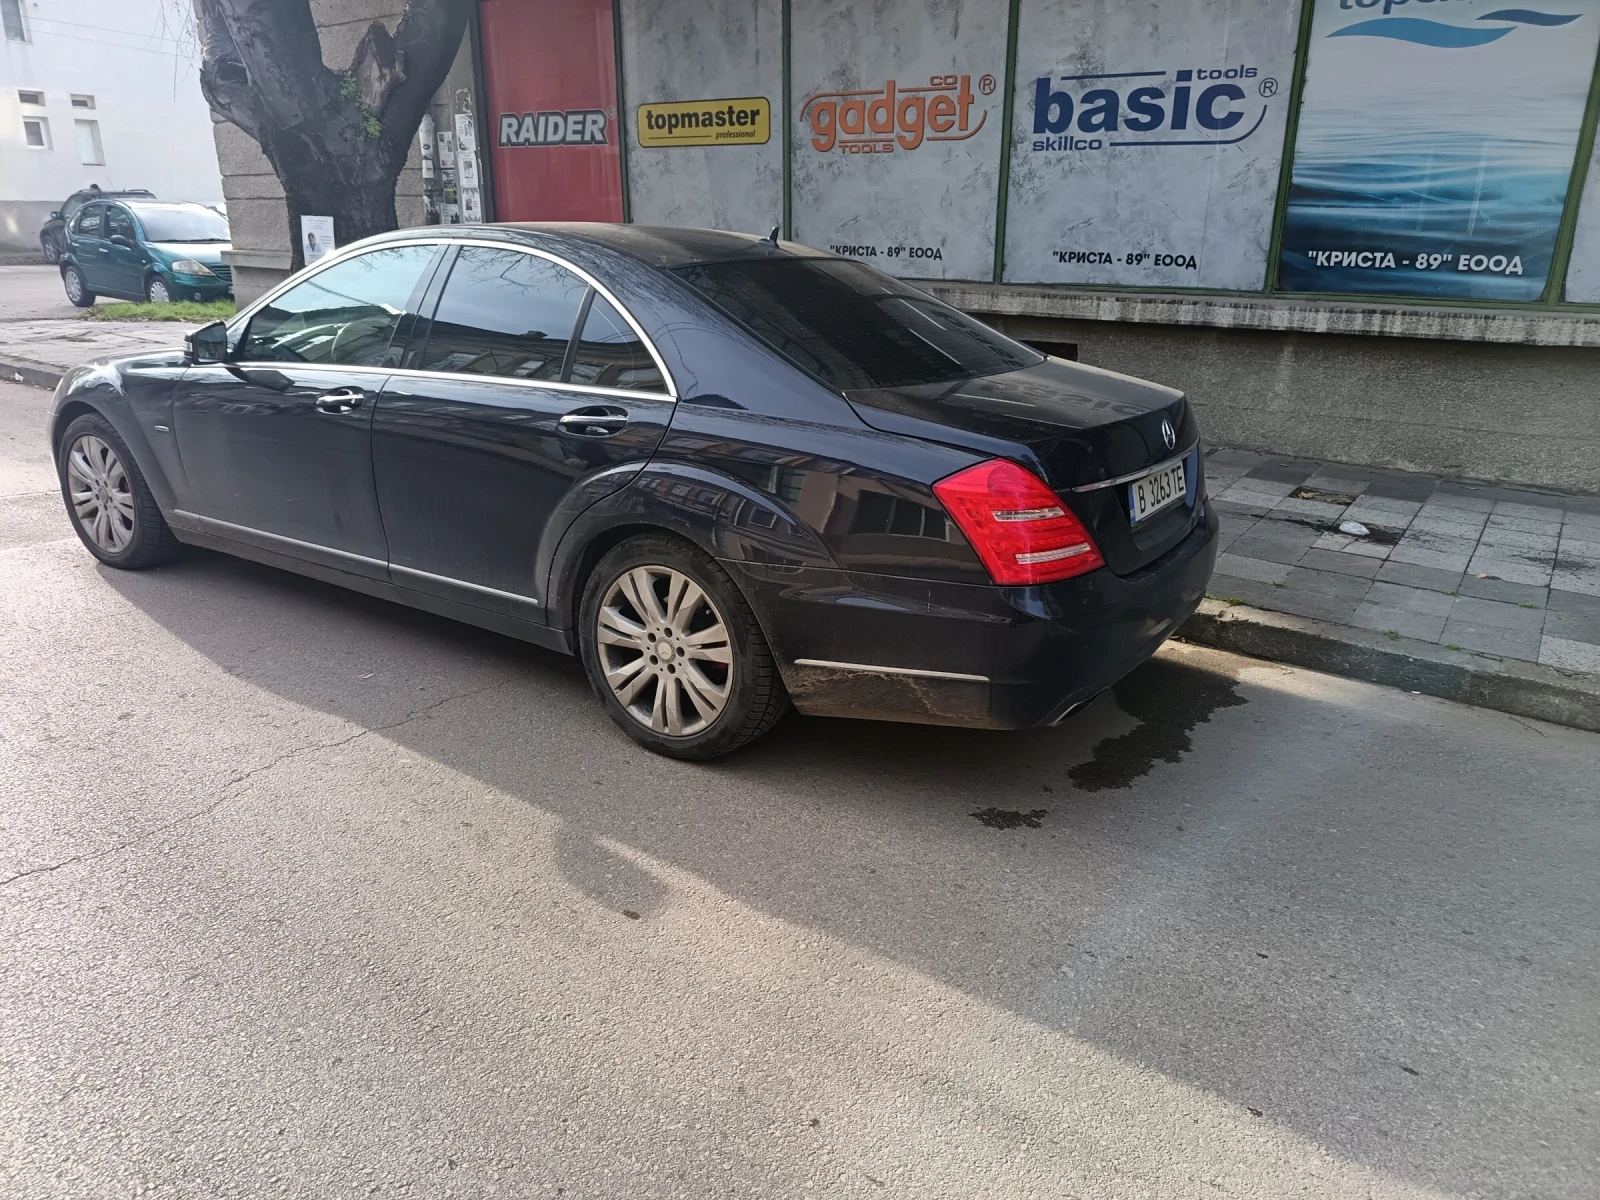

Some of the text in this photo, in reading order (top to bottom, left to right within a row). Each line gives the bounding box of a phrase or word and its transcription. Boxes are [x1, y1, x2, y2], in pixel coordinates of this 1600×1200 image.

[930, 75, 957, 86] CO
[1197, 64, 1258, 80] tools
[1033, 69, 1246, 134] basic
[646, 105, 760, 135] topmaster
[811, 75, 974, 152] gadget
[499, 111, 607, 145] RAIDER
[715, 129, 756, 140] professional
[838, 144, 894, 154] TOOLS
[1032, 136, 1103, 151] skillco
[830, 245, 877, 257] "КРИСТА
[887, 246, 906, 258] 89"
[909, 247, 942, 260] ЕООД
[1053, 251, 1113, 264] "КРИСТА
[1125, 253, 1150, 265] 89"
[1154, 254, 1197, 270] ЕООД
[1308, 251, 1396, 268] "КРИСТА
[1415, 253, 1453, 270] 89"
[1457, 255, 1524, 275] ЕООД
[1137, 465, 1185, 514] B 3263 TE
